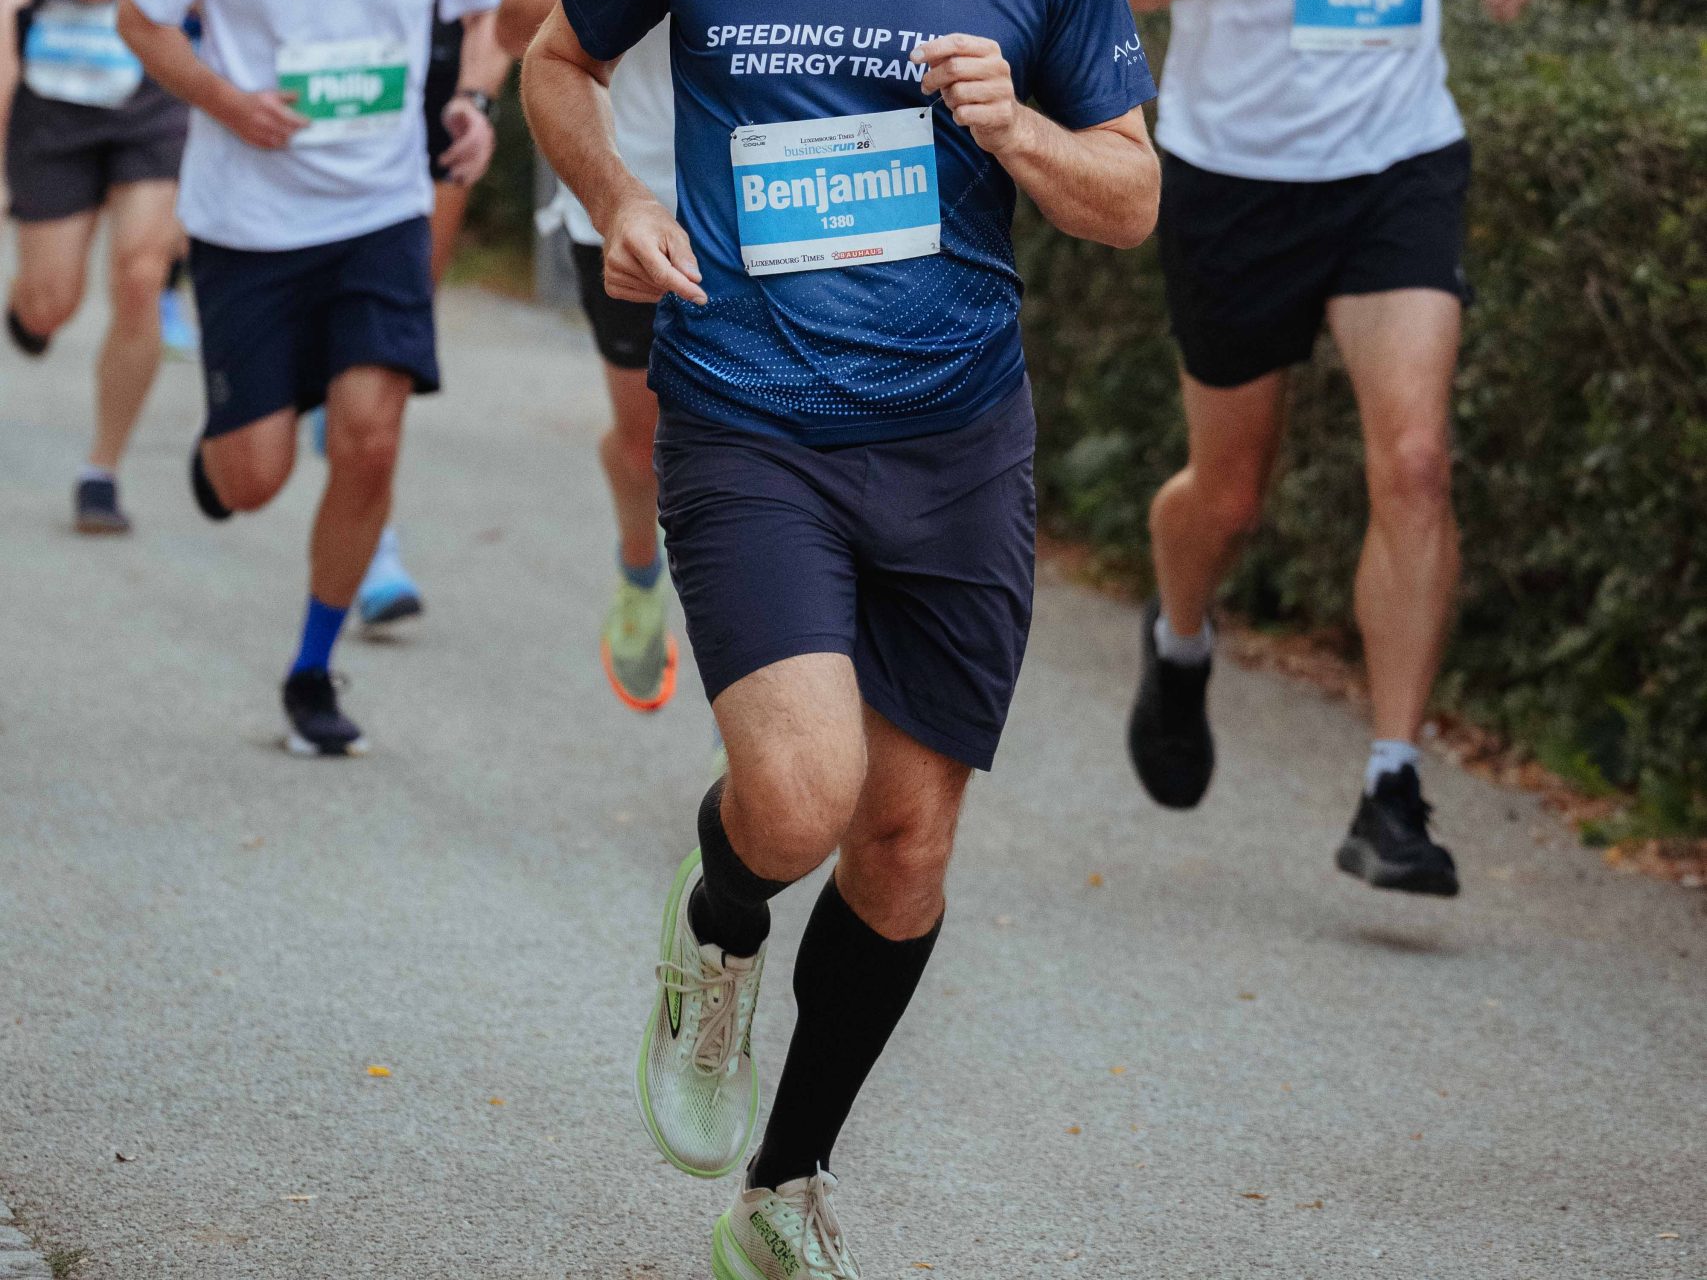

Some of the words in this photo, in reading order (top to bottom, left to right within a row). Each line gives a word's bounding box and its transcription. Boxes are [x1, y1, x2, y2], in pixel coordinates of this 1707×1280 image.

[706, 24, 845, 48] SPEEDING
[852, 27, 892, 50] UP
[898, 30, 945, 52] TH
[730, 53, 846, 75] ENERGY
[849, 56, 931, 83] TRAN
[741, 159, 928, 214] Benjamin
[820, 214, 855, 230] 1380
[840, 248, 883, 259] BAUHAUS
